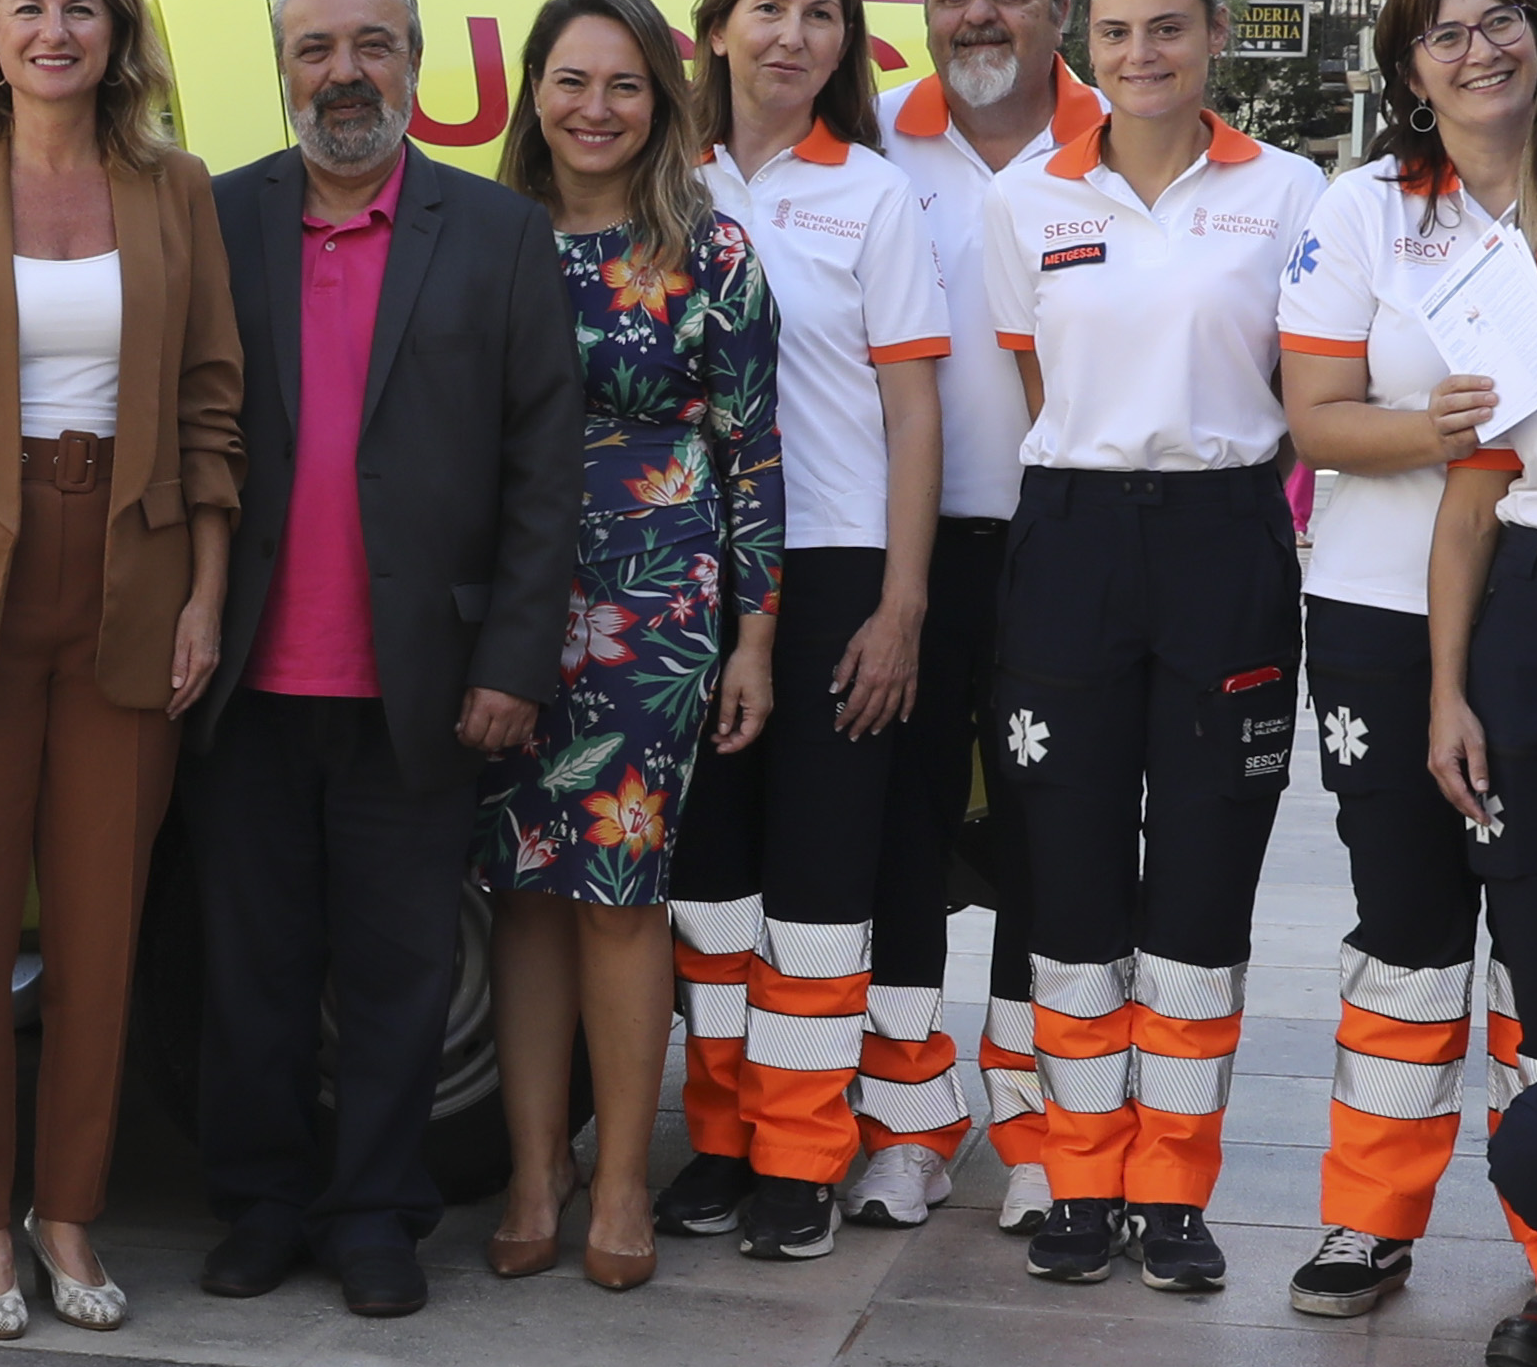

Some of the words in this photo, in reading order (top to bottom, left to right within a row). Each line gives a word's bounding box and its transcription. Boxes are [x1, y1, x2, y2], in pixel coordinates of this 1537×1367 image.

[1240, 7, 1301, 22] ADERIA
[793, 219, 862, 240] VALENCIANA
[794, 210, 867, 231] GENERALITAT
[1044, 220, 1108, 239] SESCV
[1044, 246, 1101, 265] METGESSA
[1394, 237, 1450, 257] SESCV
[1245, 751, 1285, 769] SESCV
